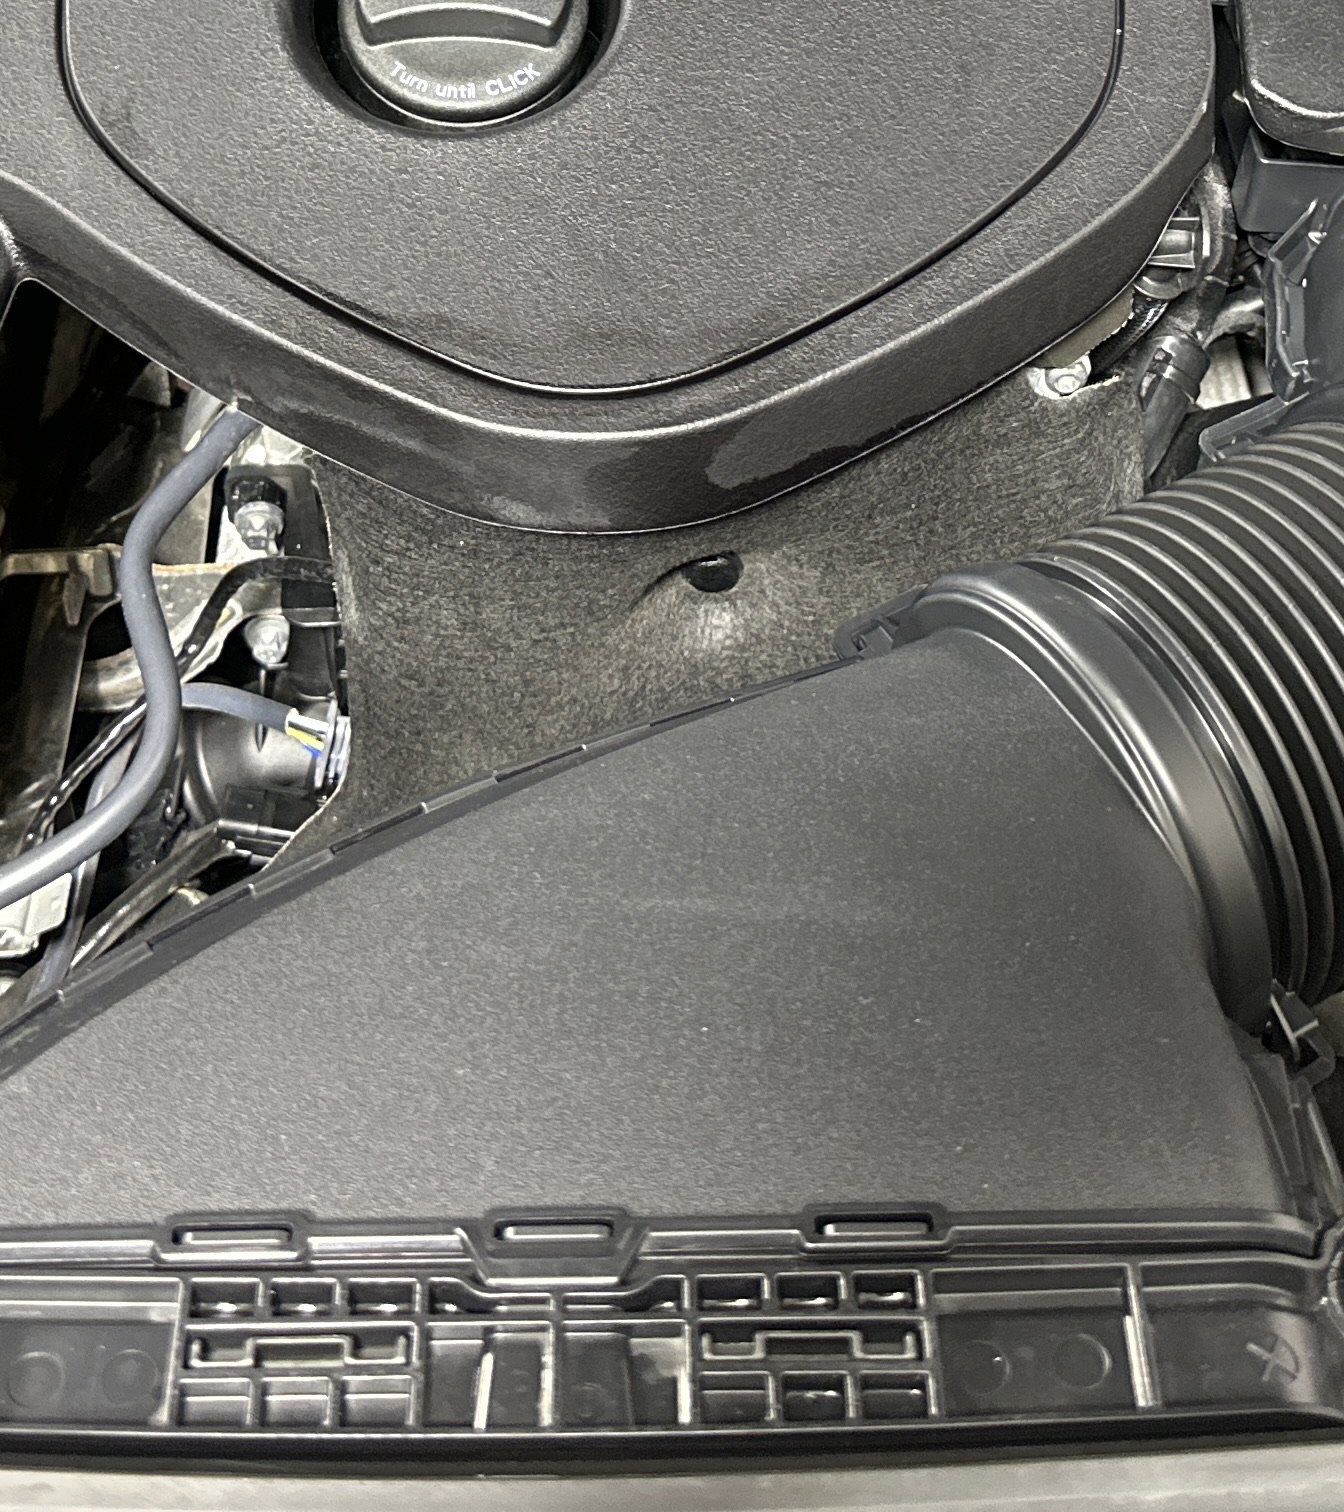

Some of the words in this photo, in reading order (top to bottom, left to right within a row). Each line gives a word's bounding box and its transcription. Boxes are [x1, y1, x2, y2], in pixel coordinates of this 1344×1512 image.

[389, 60, 429, 92] Turn
[435, 83, 476, 98] until
[484, 63, 542, 95] CLICK
